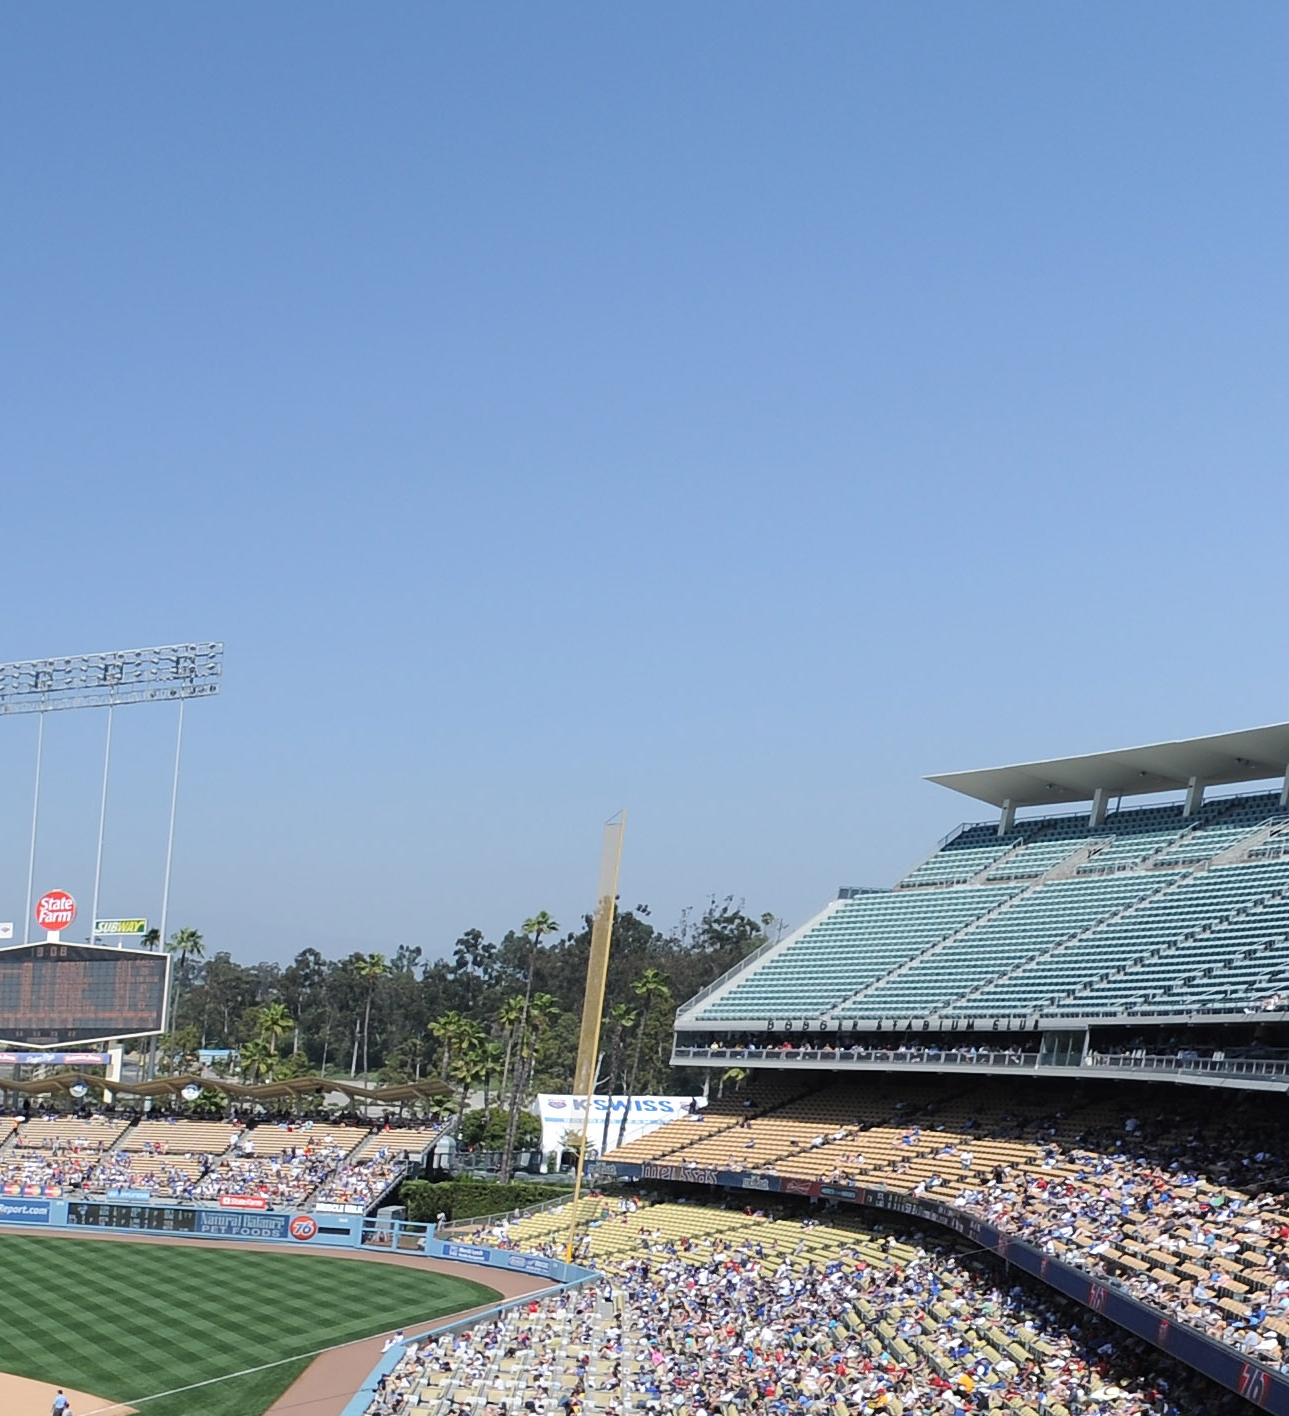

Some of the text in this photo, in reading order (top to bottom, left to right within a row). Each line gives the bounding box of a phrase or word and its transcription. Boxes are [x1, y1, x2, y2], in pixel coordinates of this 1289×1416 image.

[40, 896, 74, 910] State
[37, 909, 72, 923] Farm
[96, 921, 144, 934] SUBWAY
[200, 1211, 241, 1227] Natural
[202, 1225, 280, 1237] PET FOODS
[293, 1222, 313, 1235] 76
[1239, 1362, 1270, 1406] 76
